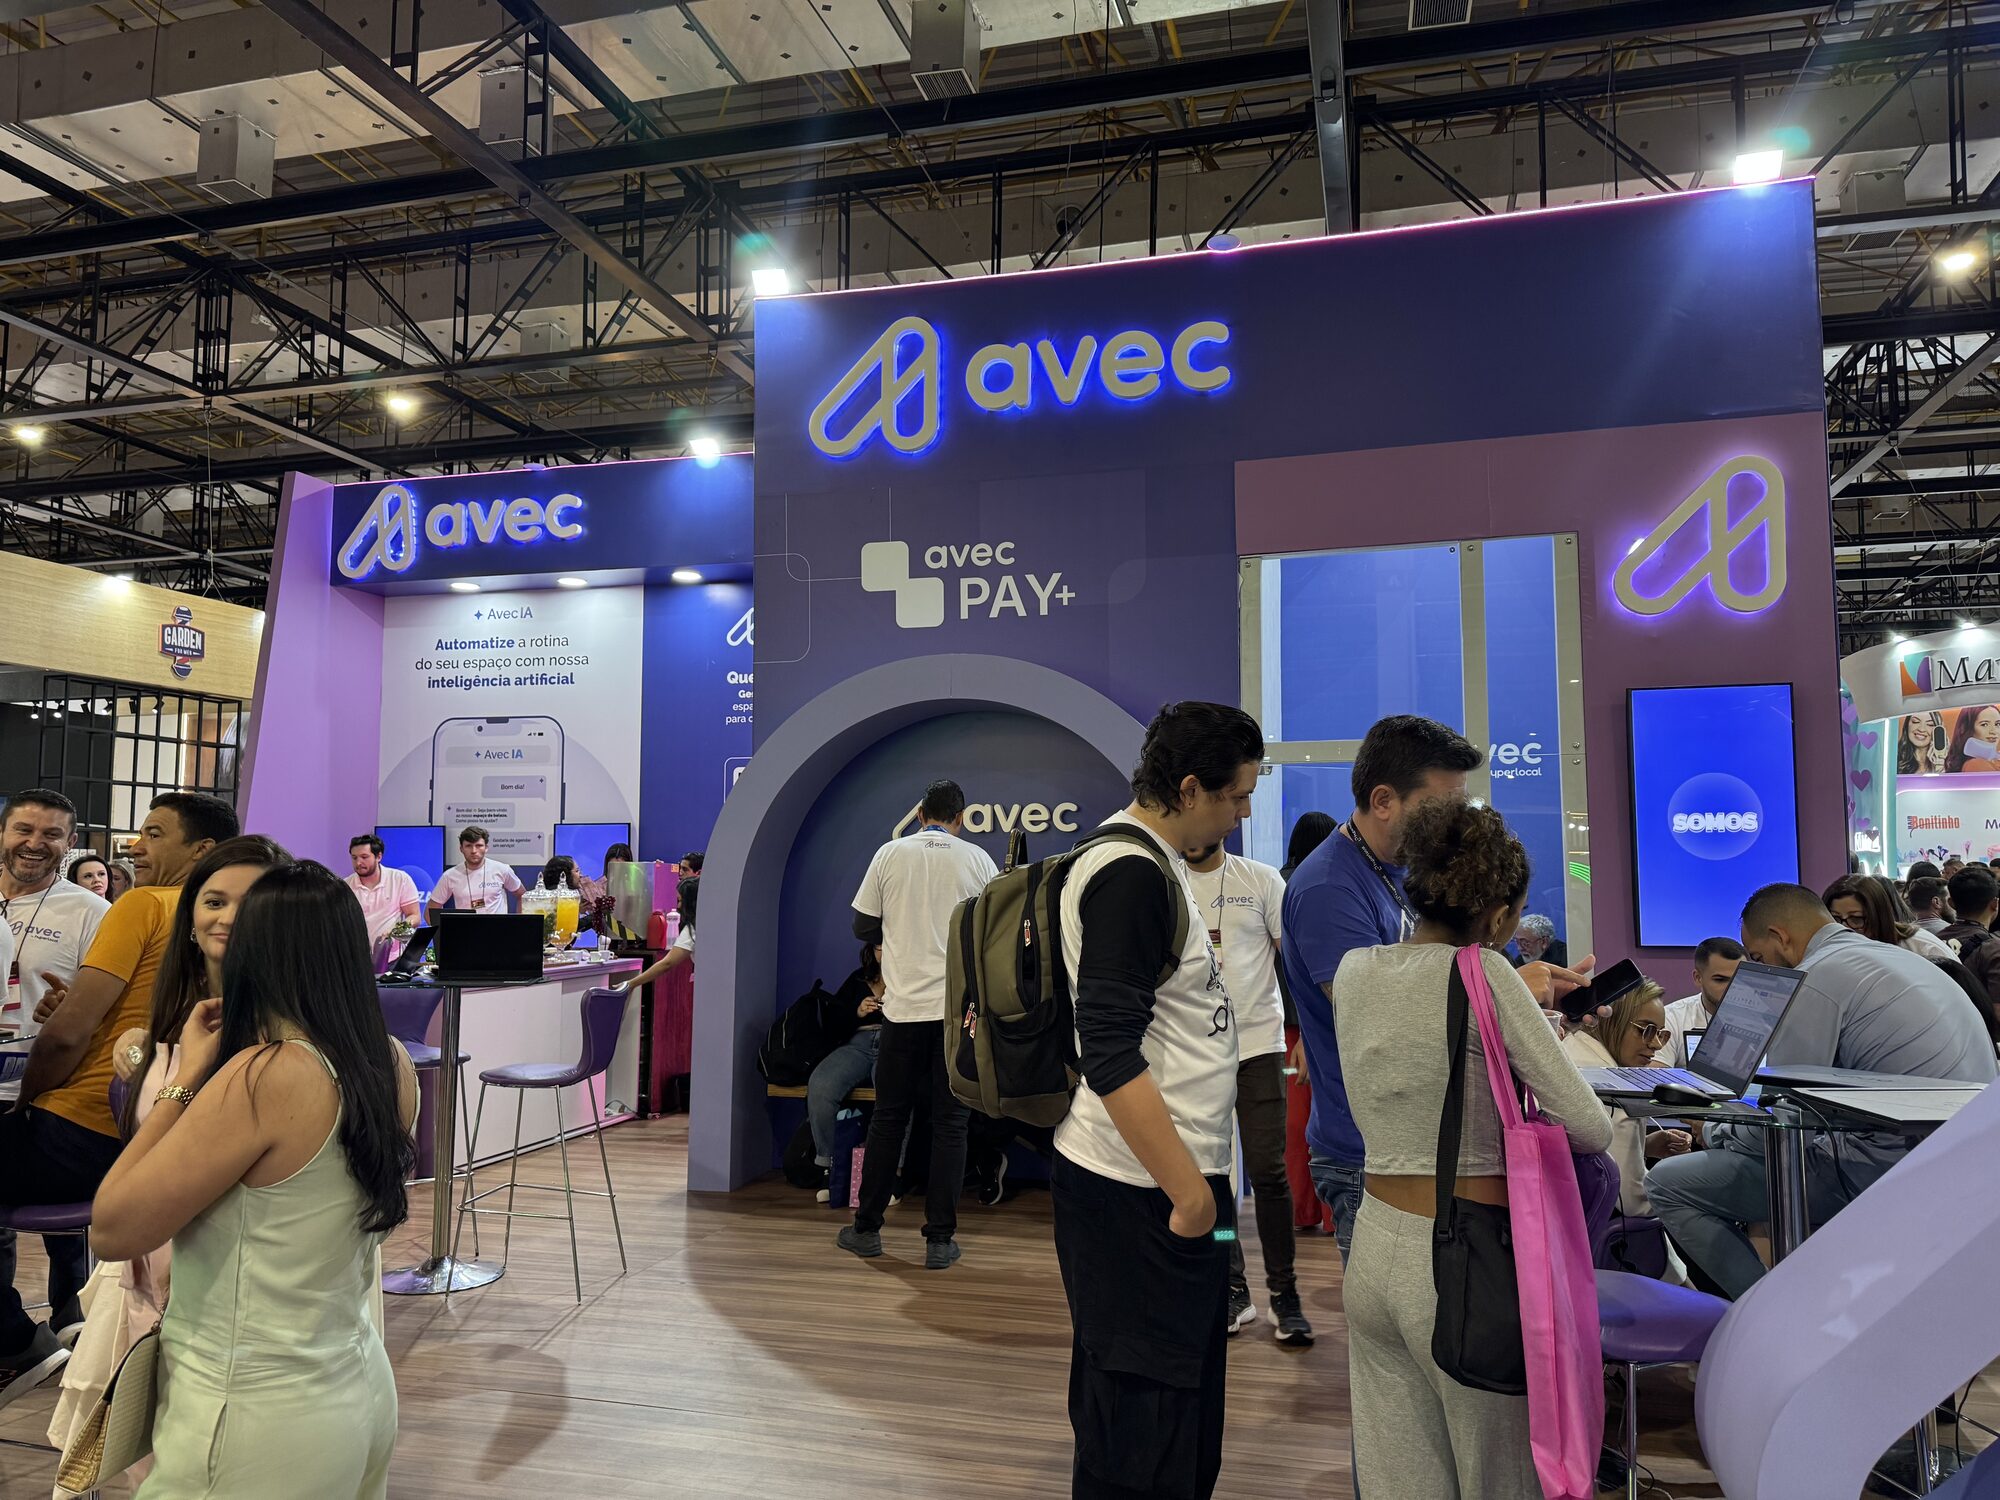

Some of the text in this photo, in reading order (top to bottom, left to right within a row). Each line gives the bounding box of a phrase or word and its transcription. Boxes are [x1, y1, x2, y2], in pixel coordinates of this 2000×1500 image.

[965, 321, 1230, 410] avec
[424, 493, 583, 548] avec
[924, 540, 1015, 569] avec
[487, 608, 518, 620] Avec
[164, 626, 202, 650] GARDEN
[435, 635, 569, 650] Automatize a rotina
[415, 655, 589, 672] do seu espaço com nossa
[427, 672, 575, 690] inteligência artificial
[725, 716, 746, 725] para
[484, 749, 523, 759] Avec IA
[1489, 743, 1542, 764] vec
[1490, 767, 1542, 778] yperlocal
[963, 802, 1079, 833] avec
[1672, 812, 1759, 833] SOMOS
[1912, 815, 1960, 829] Bonitinho
[24, 925, 62, 938] avec
